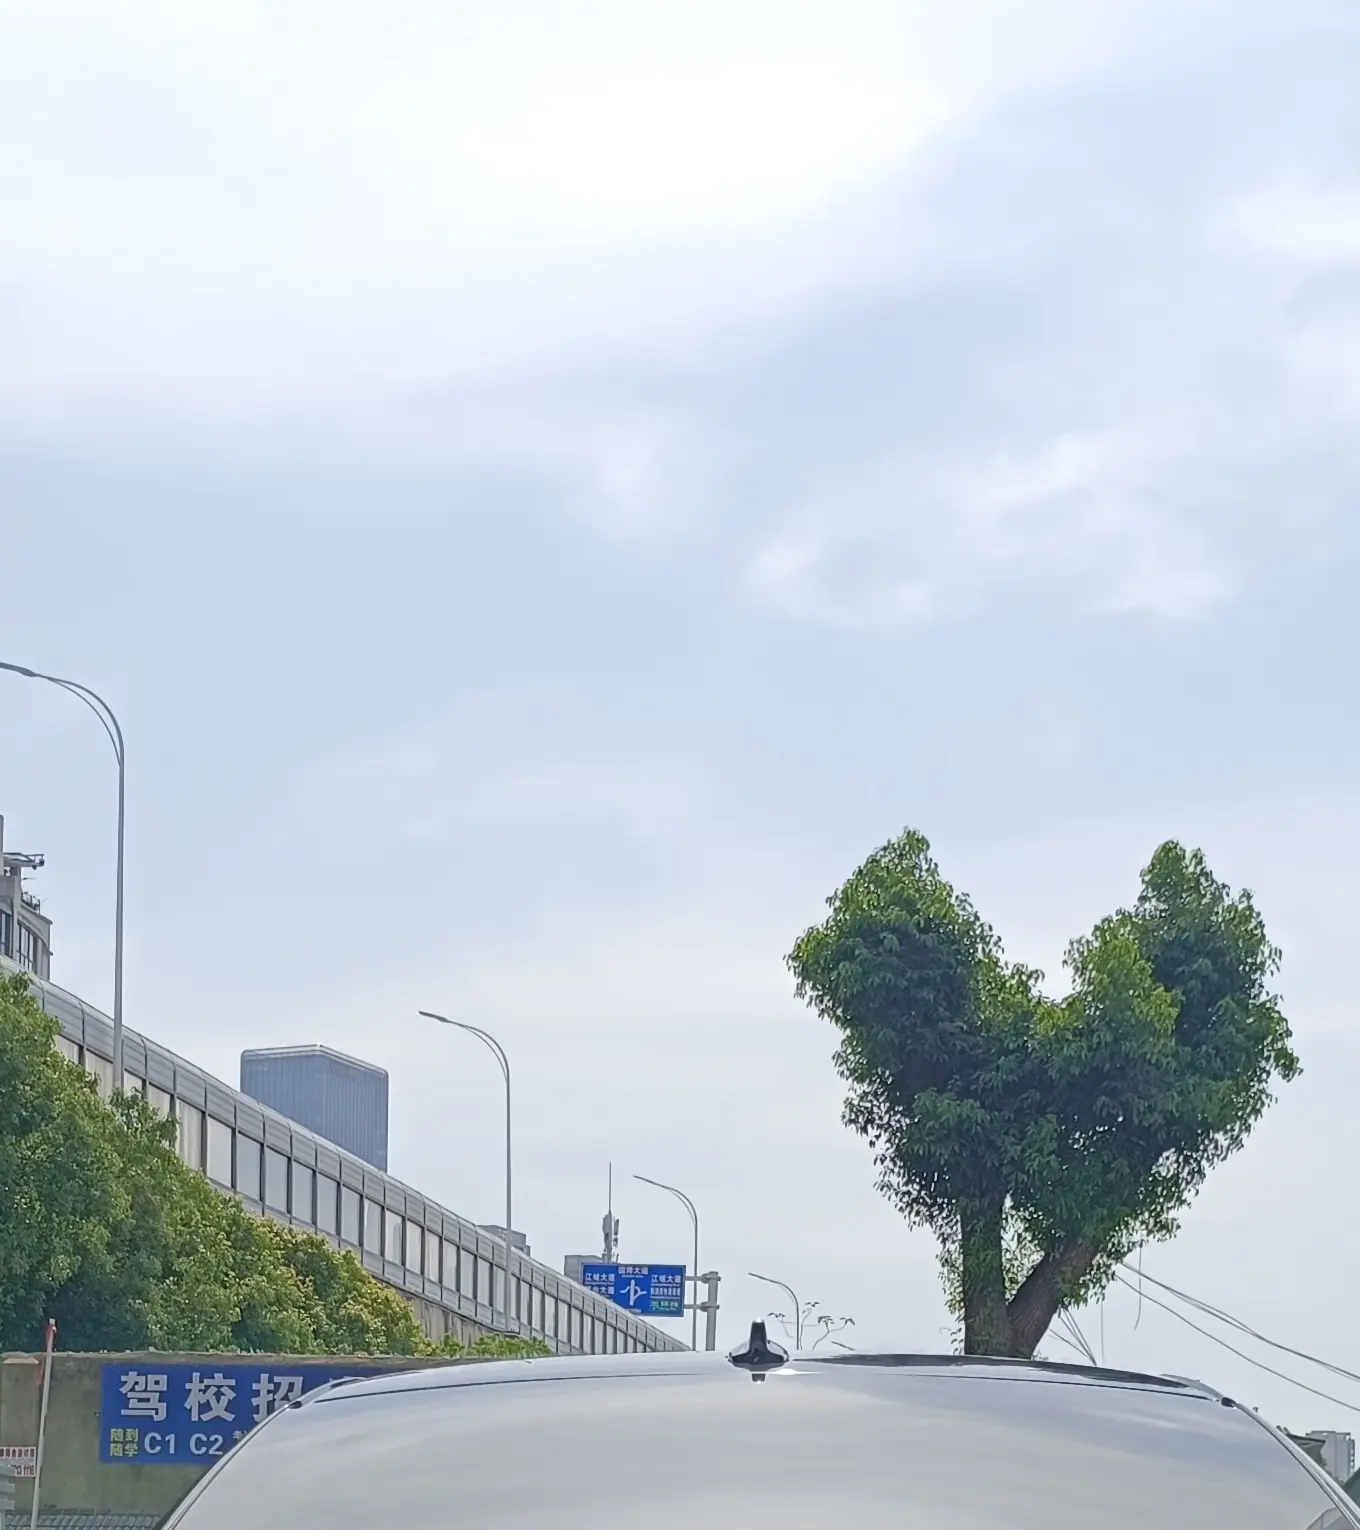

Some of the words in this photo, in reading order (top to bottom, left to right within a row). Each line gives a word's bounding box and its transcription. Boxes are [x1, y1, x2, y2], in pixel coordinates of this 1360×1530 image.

[119, 1371, 338, 1424] 驾校招
[144, 1432, 175, 1454] C1
[189, 1433, 224, 1455] C2
